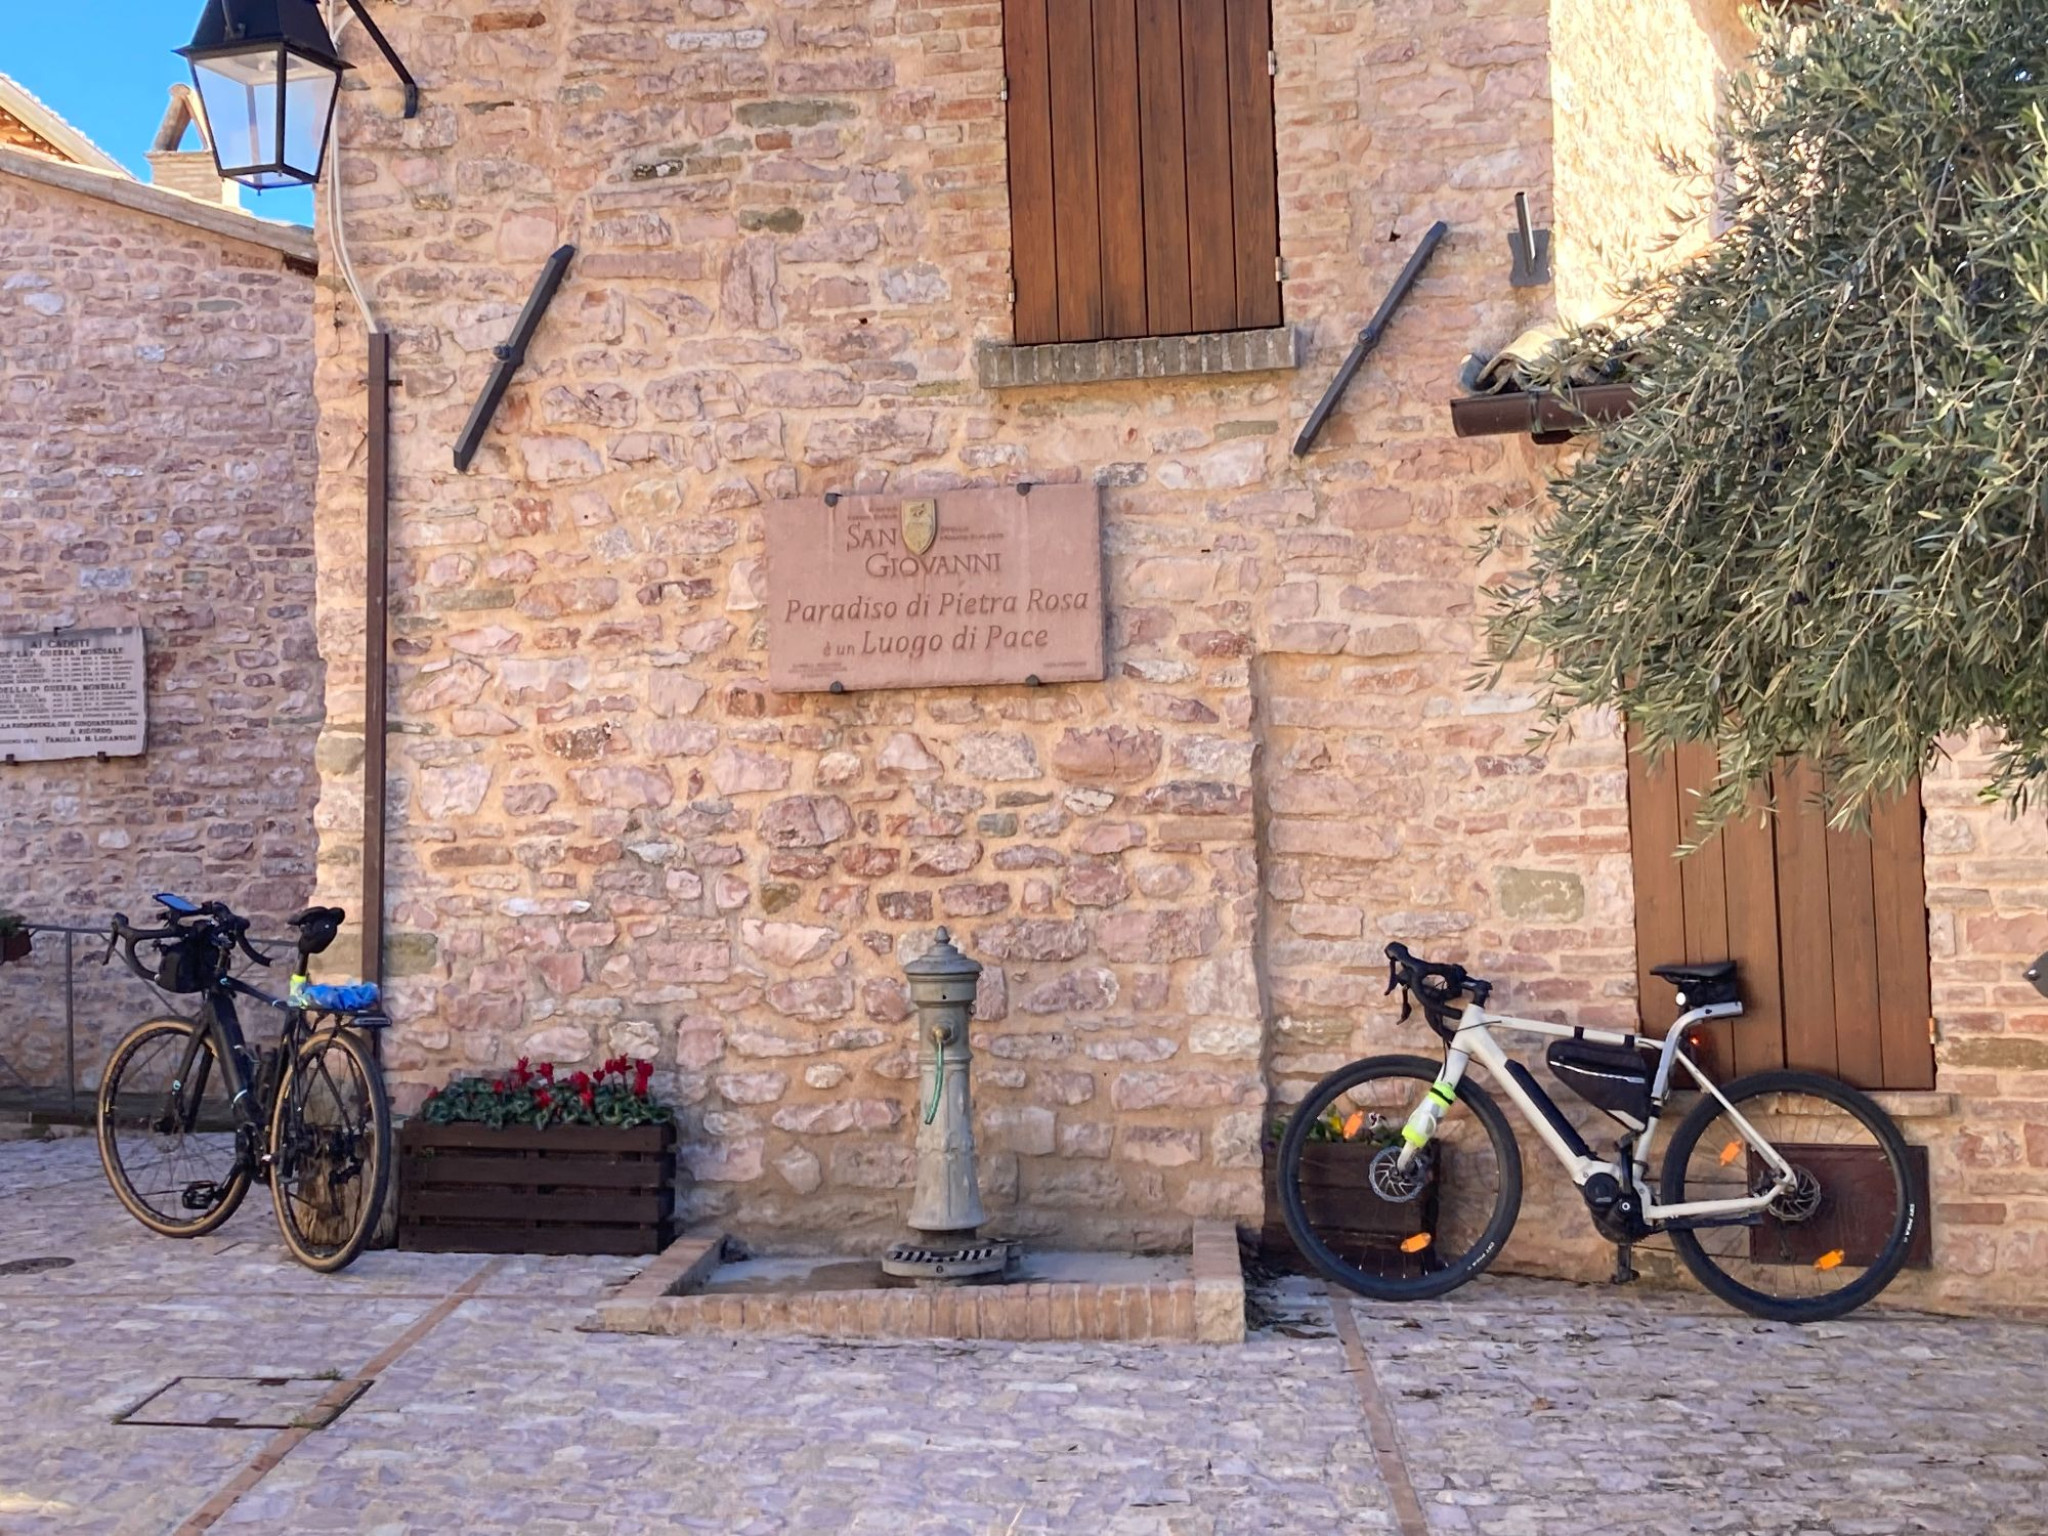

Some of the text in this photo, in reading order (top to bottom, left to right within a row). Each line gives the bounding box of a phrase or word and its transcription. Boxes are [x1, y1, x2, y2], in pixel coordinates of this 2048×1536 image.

[846, 522, 897, 552] SAN
[865, 552, 1001, 579] GIOVANNI
[784, 588, 1089, 623] Paradiso di Pietra Rosa
[31, 639, 89, 648] AI CADUTI
[39, 649, 75, 657] GUERRA
[80, 647, 123, 655] MONDIALE
[823, 625, 1049, 660] è un Luogo di Pace
[44, 685, 78, 693] GUERRA
[83, 682, 126, 691] MONDIALE
